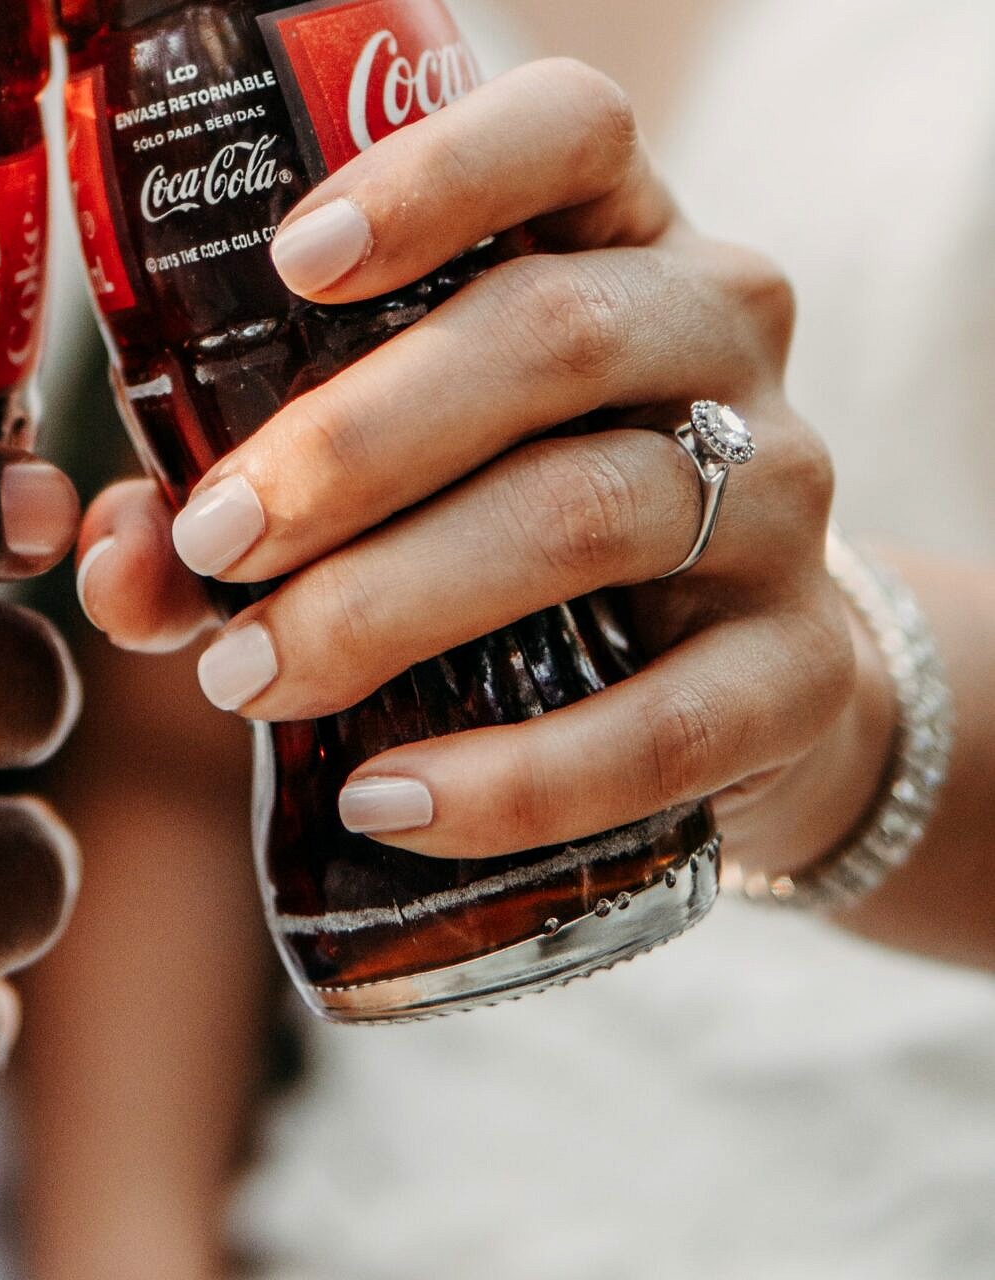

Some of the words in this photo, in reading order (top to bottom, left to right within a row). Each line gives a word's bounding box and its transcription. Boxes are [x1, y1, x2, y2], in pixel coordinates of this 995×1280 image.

[166, 64, 199, 85] LCD
[115, 101, 168, 130] ENVASE
[169, 71, 276, 113] RETORNABLE
[167, 123, 203, 142] PARA
[205, 105, 266, 132] BEBIDAS
[180, 246, 200, 265] THE
